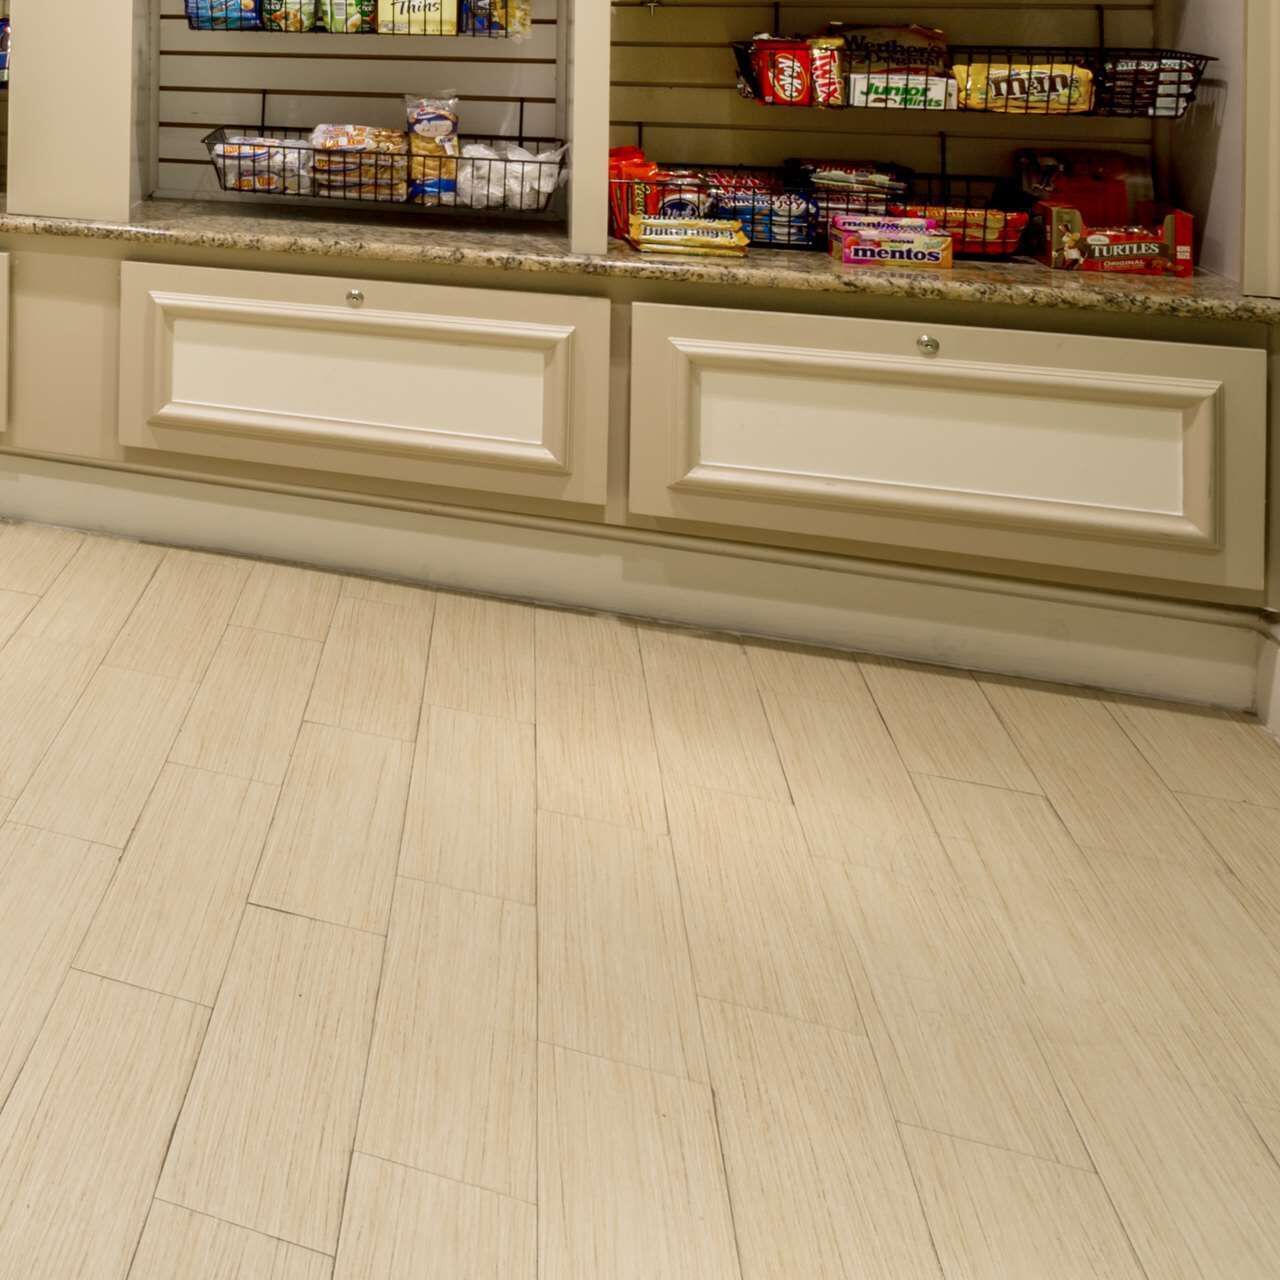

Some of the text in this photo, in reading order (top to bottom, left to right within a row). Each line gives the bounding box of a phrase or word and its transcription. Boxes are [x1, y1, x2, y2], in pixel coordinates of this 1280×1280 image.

[392, 0, 440, 15] Thins
[860, 81, 931, 97] Junior
[898, 95, 943, 108] Mints
[853, 246, 941, 262] mentos
[1091, 243, 1159, 257] TURTLES
[1104, 259, 1145, 267] ORIGINAL
